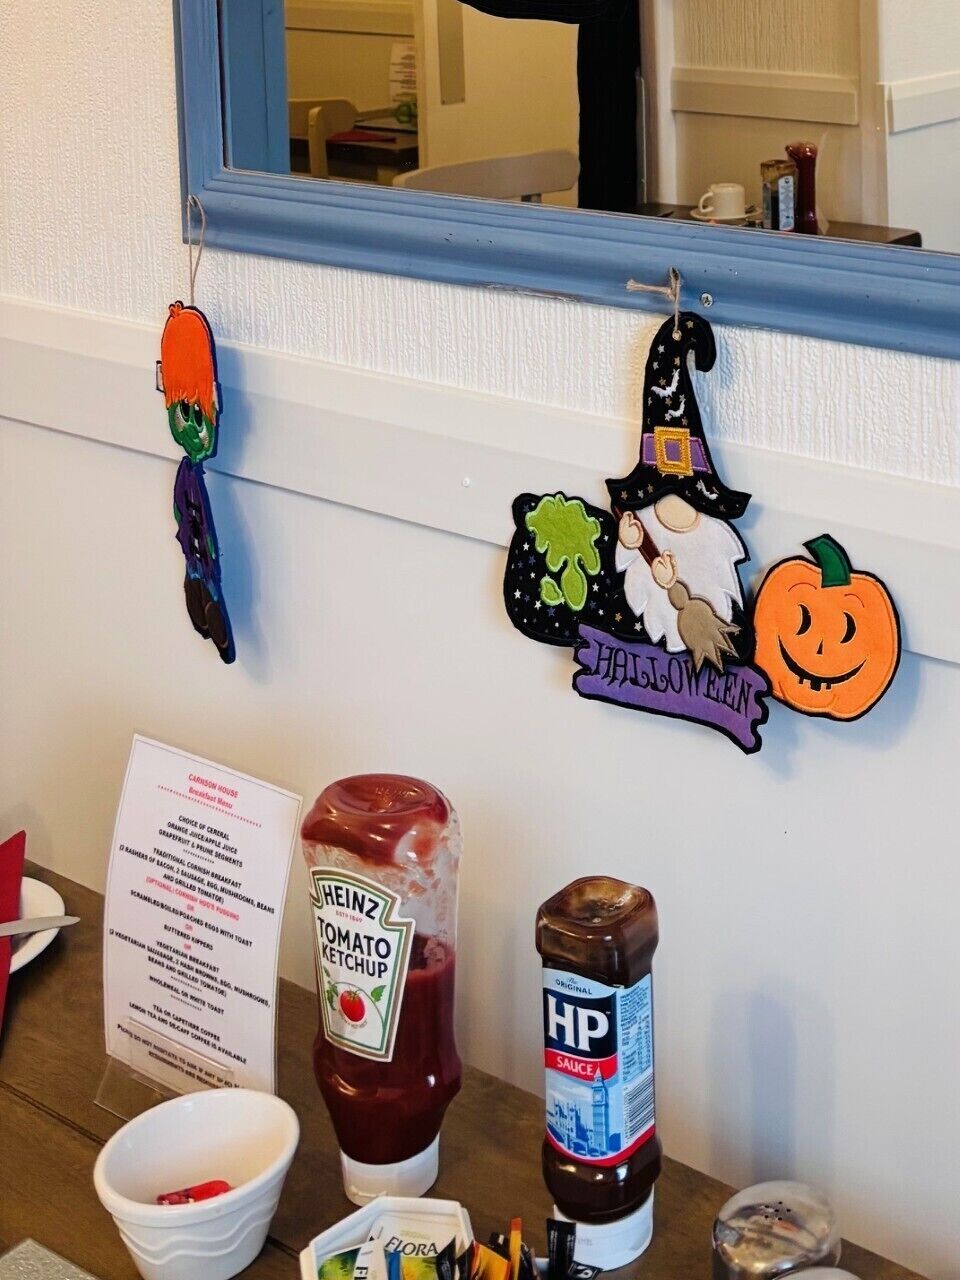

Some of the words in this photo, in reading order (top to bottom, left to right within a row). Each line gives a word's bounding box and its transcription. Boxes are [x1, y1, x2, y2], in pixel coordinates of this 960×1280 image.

[592, 639, 753, 718] HALLOWEEN
[217, 785, 238, 798] HOUSE
[179, 815, 198, 828] CHOICE
[322, 885, 379, 920] HEINZ
[317, 916, 391, 959] TOMATO
[322, 944, 388, 979] KETCHUP
[555, 979, 593, 995] ORIGINAL
[547, 994, 609, 1052] HP
[557, 1056, 594, 1076] SAUCE
[385, 1236, 439, 1257] FLORA
